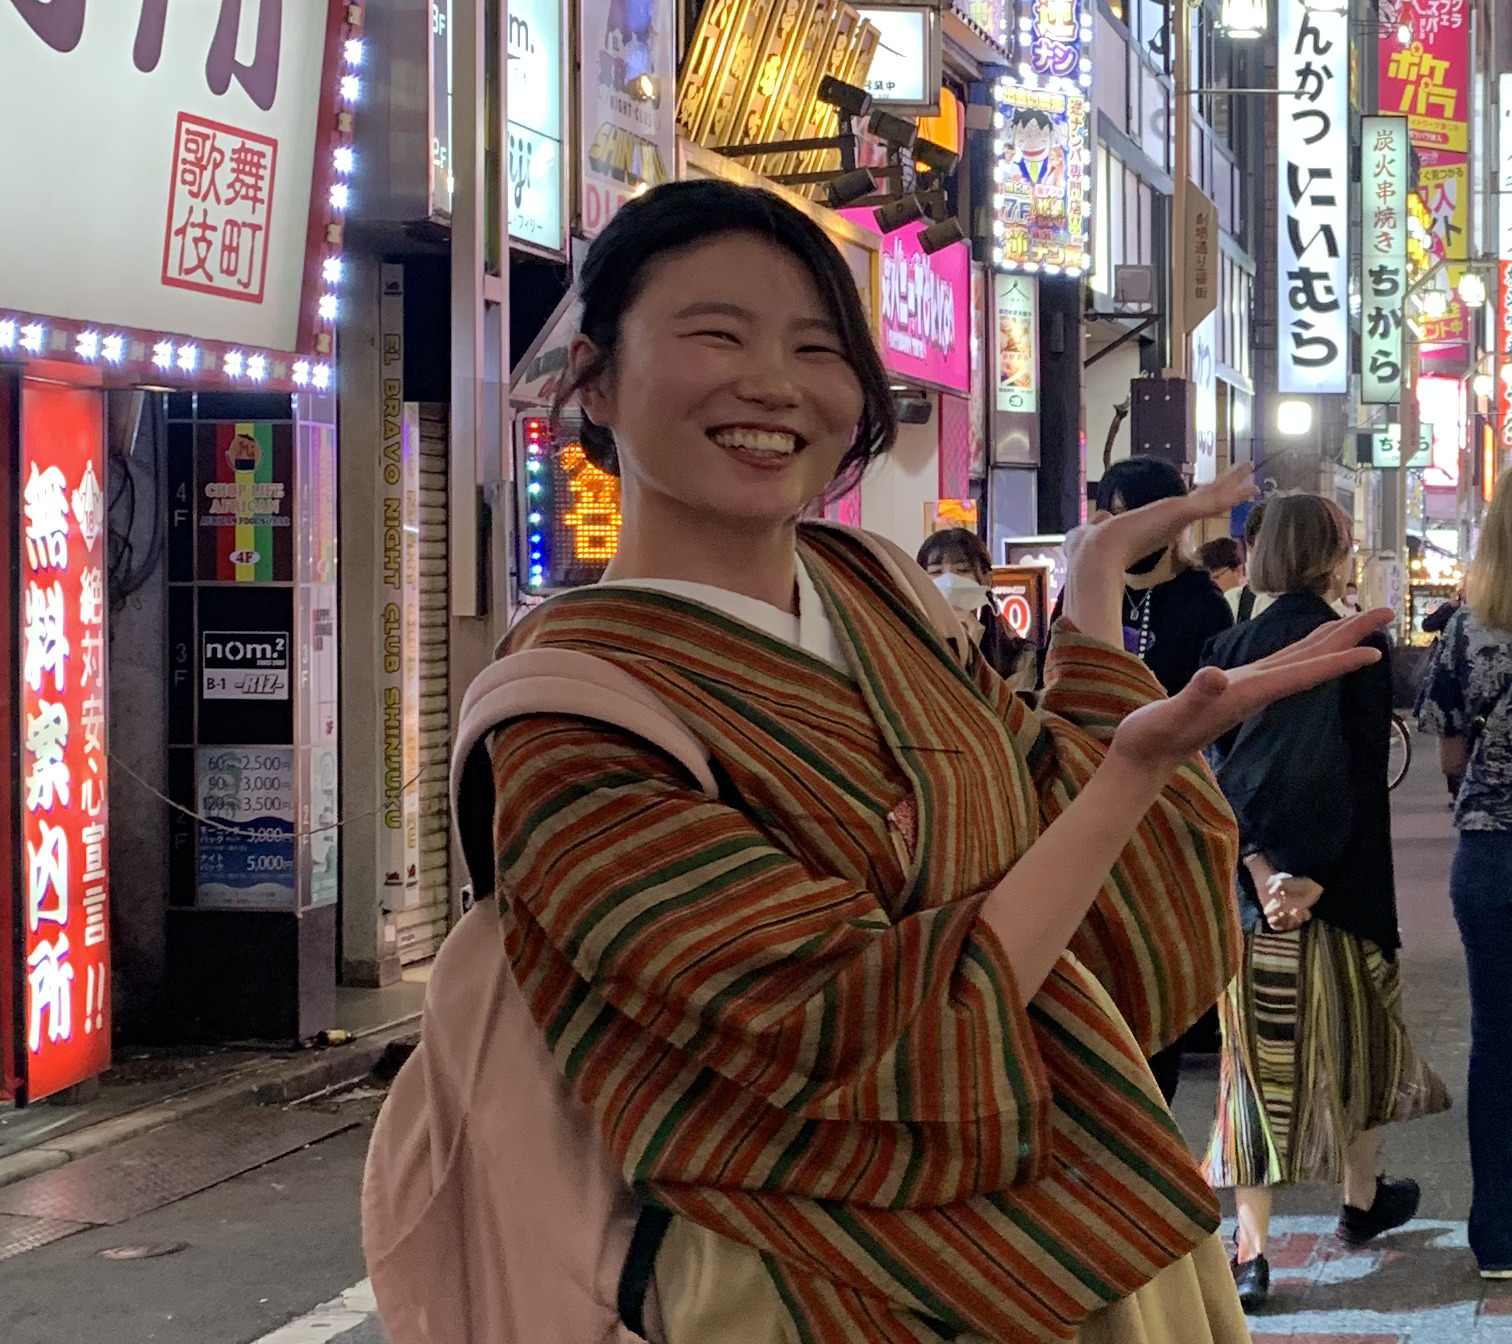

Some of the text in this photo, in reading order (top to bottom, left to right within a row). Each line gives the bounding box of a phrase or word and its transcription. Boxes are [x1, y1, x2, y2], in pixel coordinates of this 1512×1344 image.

[432, 3, 446, 35] 3F
[1372, 128, 1400, 255] 炭火串焼き
[1286, 160, 1340, 368] にいむら
[1367, 263, 1400, 385] ちから
[1379, 436, 1430, 452] ちら
[236, 550, 255, 563] 4F
[383, 333, 401, 831] EL BRAVO NIGHT CLUB SHINJUKU
[206, 677, 227, 690] B-1
[24, 459, 71, 1054] 無料案内所
[78, 565, 107, 1033] 絶対安心宣言!!
